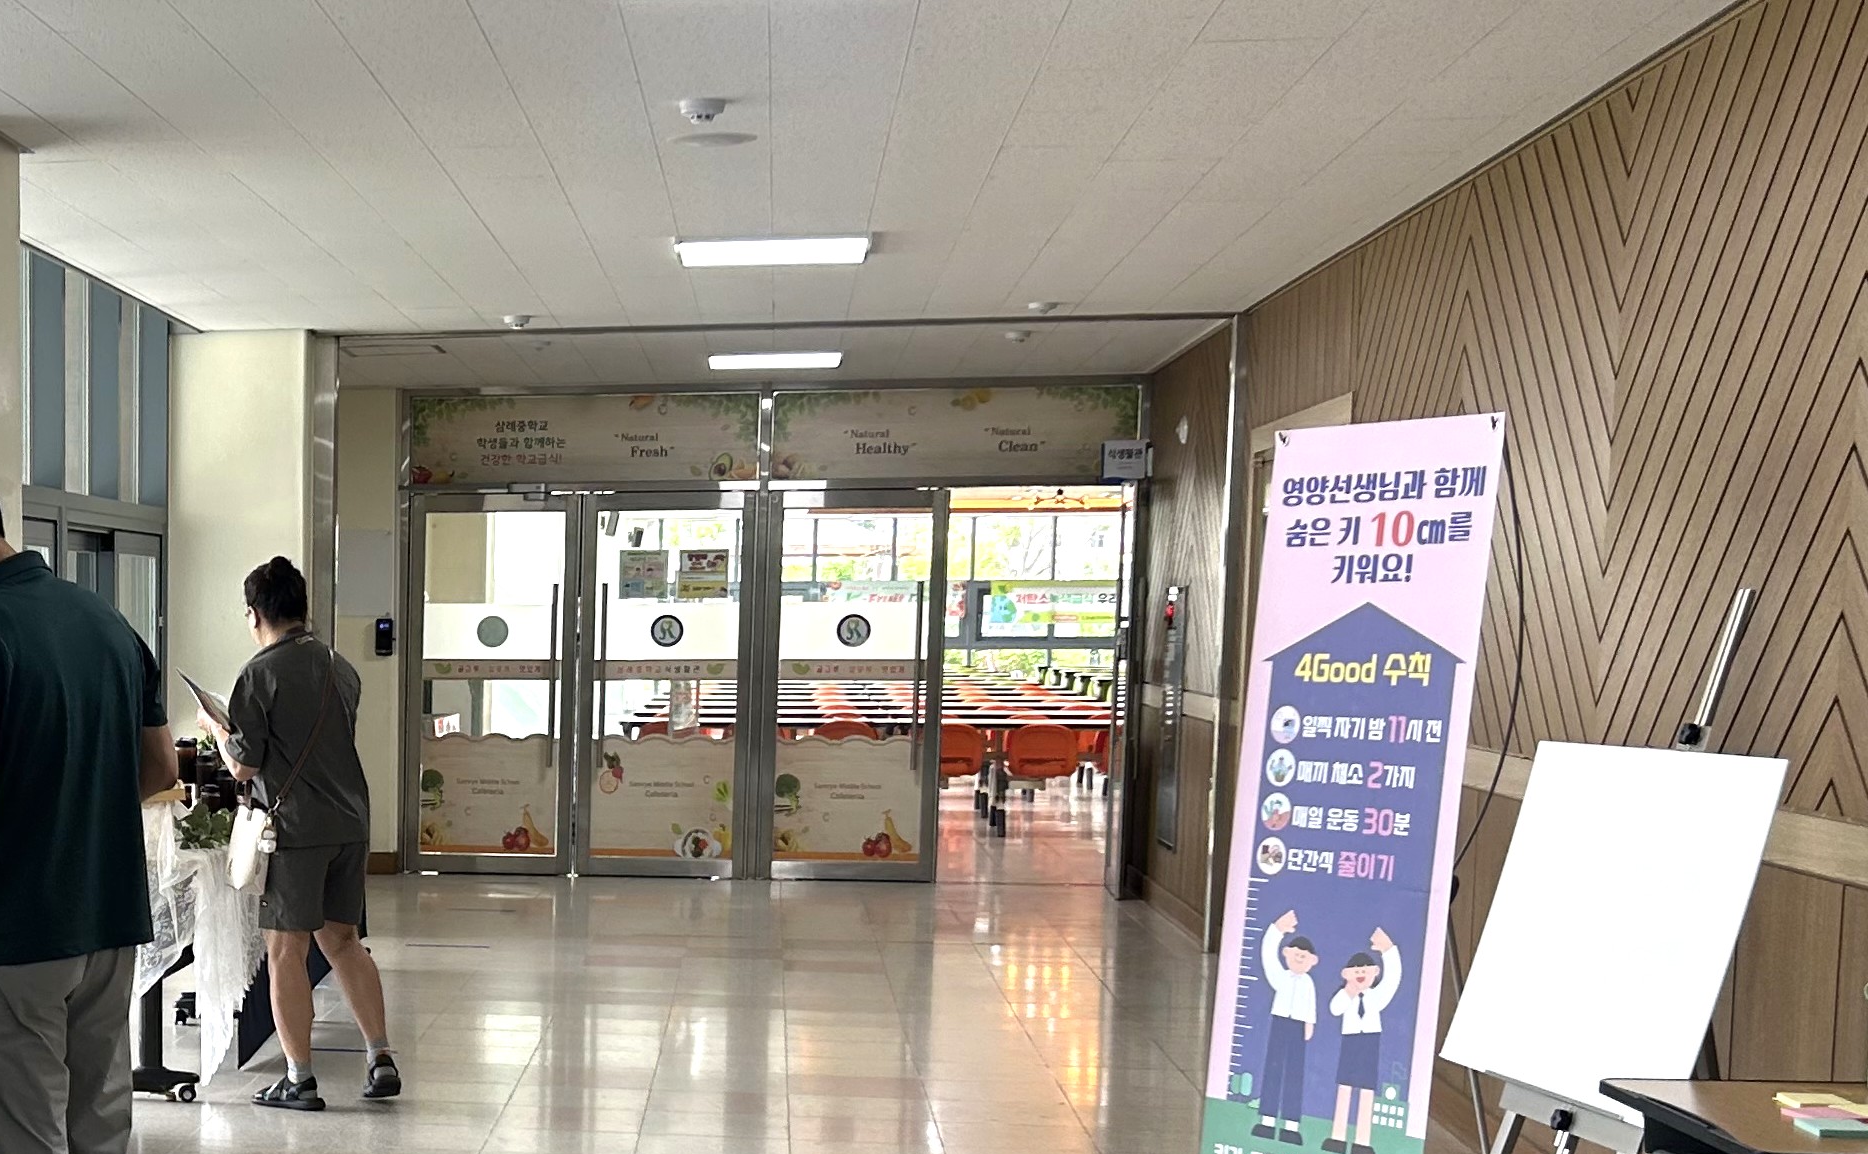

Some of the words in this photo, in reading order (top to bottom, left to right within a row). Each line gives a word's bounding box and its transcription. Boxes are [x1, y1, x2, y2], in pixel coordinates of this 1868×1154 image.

[494, 420, 549, 432] 삼례중학교
[1282, 469, 1427, 507] 영양선생님과
[1433, 465, 1487, 498] 함께
[1285, 516, 1331, 548] 숨은
[1336, 515, 1361, 546] 키
[1330, 553, 1414, 584] 키워요!
[1294, 653, 1378, 684] 4Good
[1383, 651, 1431, 687] 수칙
[1302, 715, 1333, 738] 일찍
[1333, 716, 1366, 740] 자기
[1367, 717, 1386, 741] 밤
[1388, 715, 1422, 743] 11시
[1425, 719, 1443, 743] 전
[1296, 760, 1328, 784] 매끼
[1331, 761, 1364, 785] 채소
[1366, 761, 1416, 789] 2가지
[1292, 805, 1323, 830] 매일
[1326, 807, 1360, 832] 운동
[1362, 807, 1411, 836] 30분
[1337, 851, 1395, 882] 줄이기
